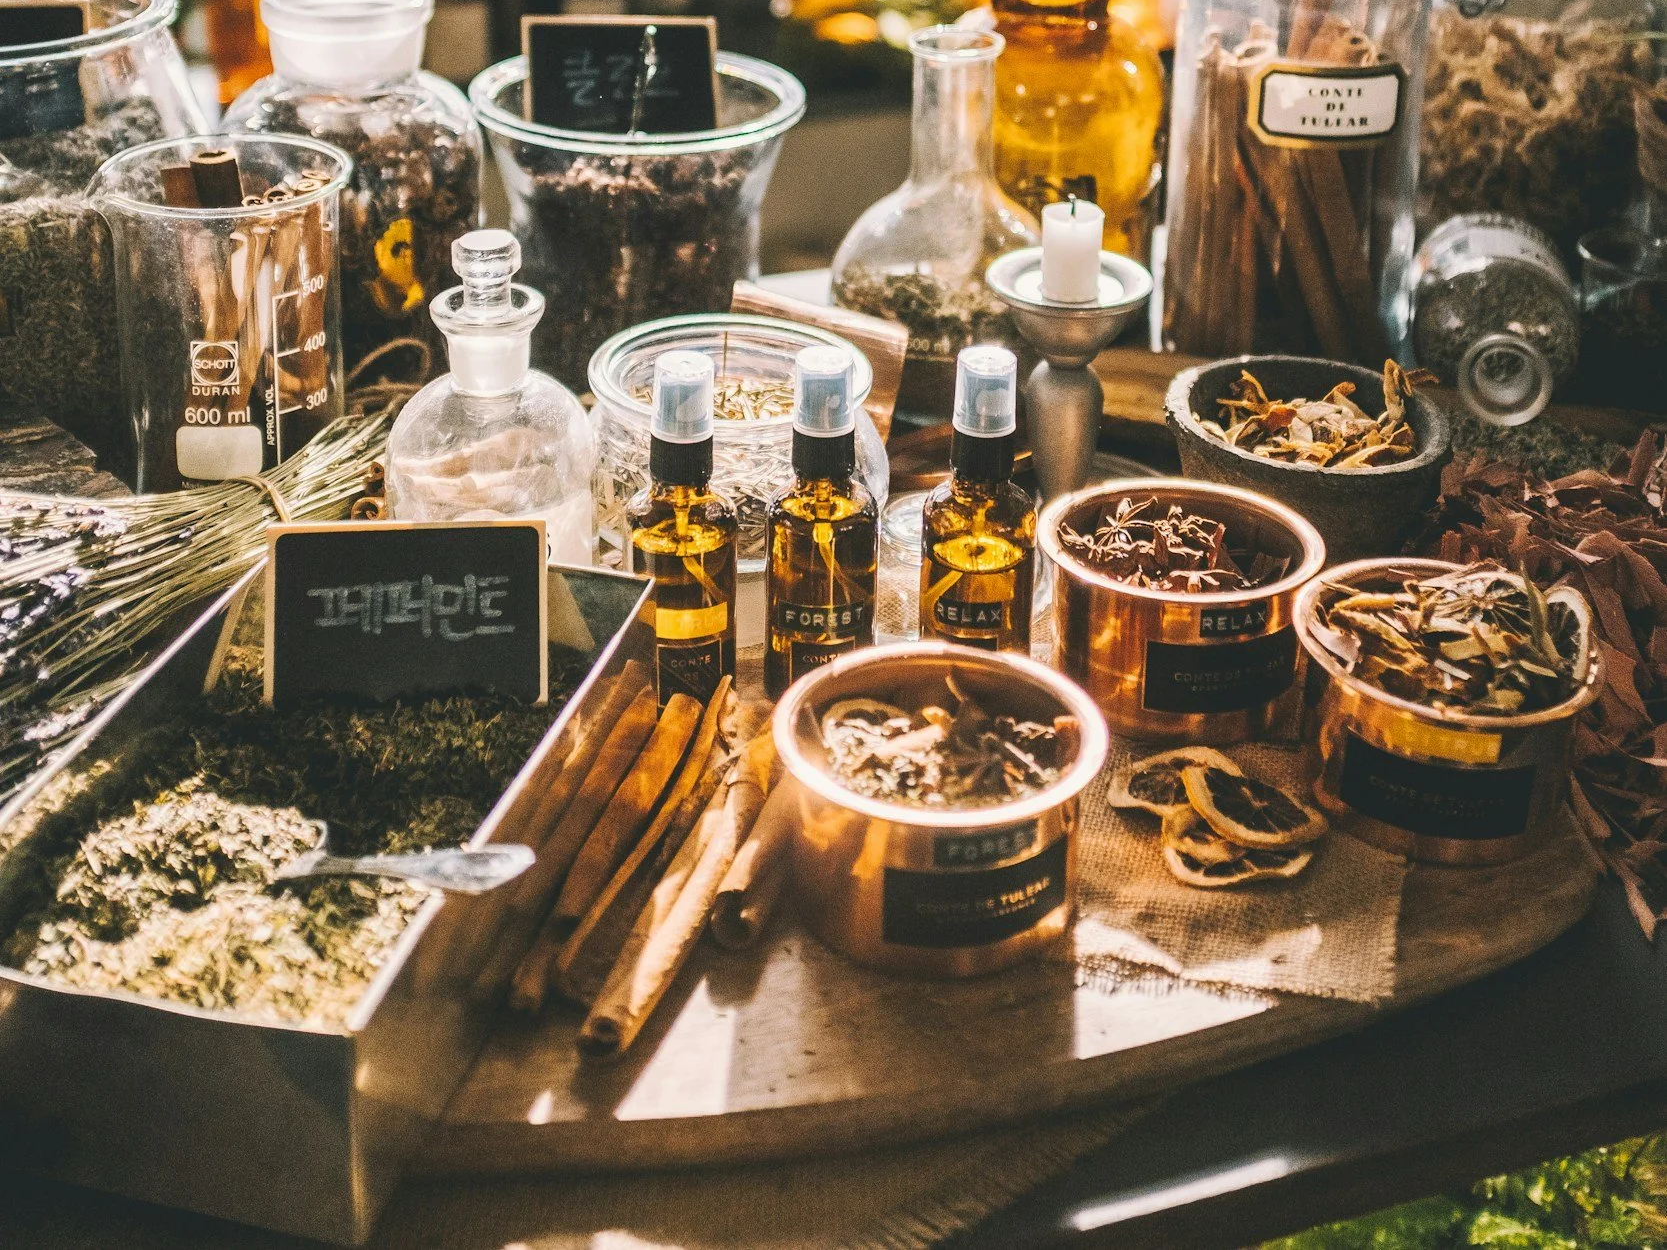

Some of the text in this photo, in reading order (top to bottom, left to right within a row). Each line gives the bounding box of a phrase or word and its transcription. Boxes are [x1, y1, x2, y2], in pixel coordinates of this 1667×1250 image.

[304, 331, 327, 352] 400
[194, 358, 236, 371] SCHOTT
[191, 385, 241, 397] DURAN
[306, 387, 329, 410] 300
[184, 405, 251, 426] 600 ml
[307, 574, 516, 642] 페퍼민트
[784, 607, 864, 627] FOREST
[937, 602, 1001, 623] RELAX
[1202, 610, 1266, 631] RELAX
[670, 654, 712, 668] CONTE
[802, 652, 841, 665] CONT
